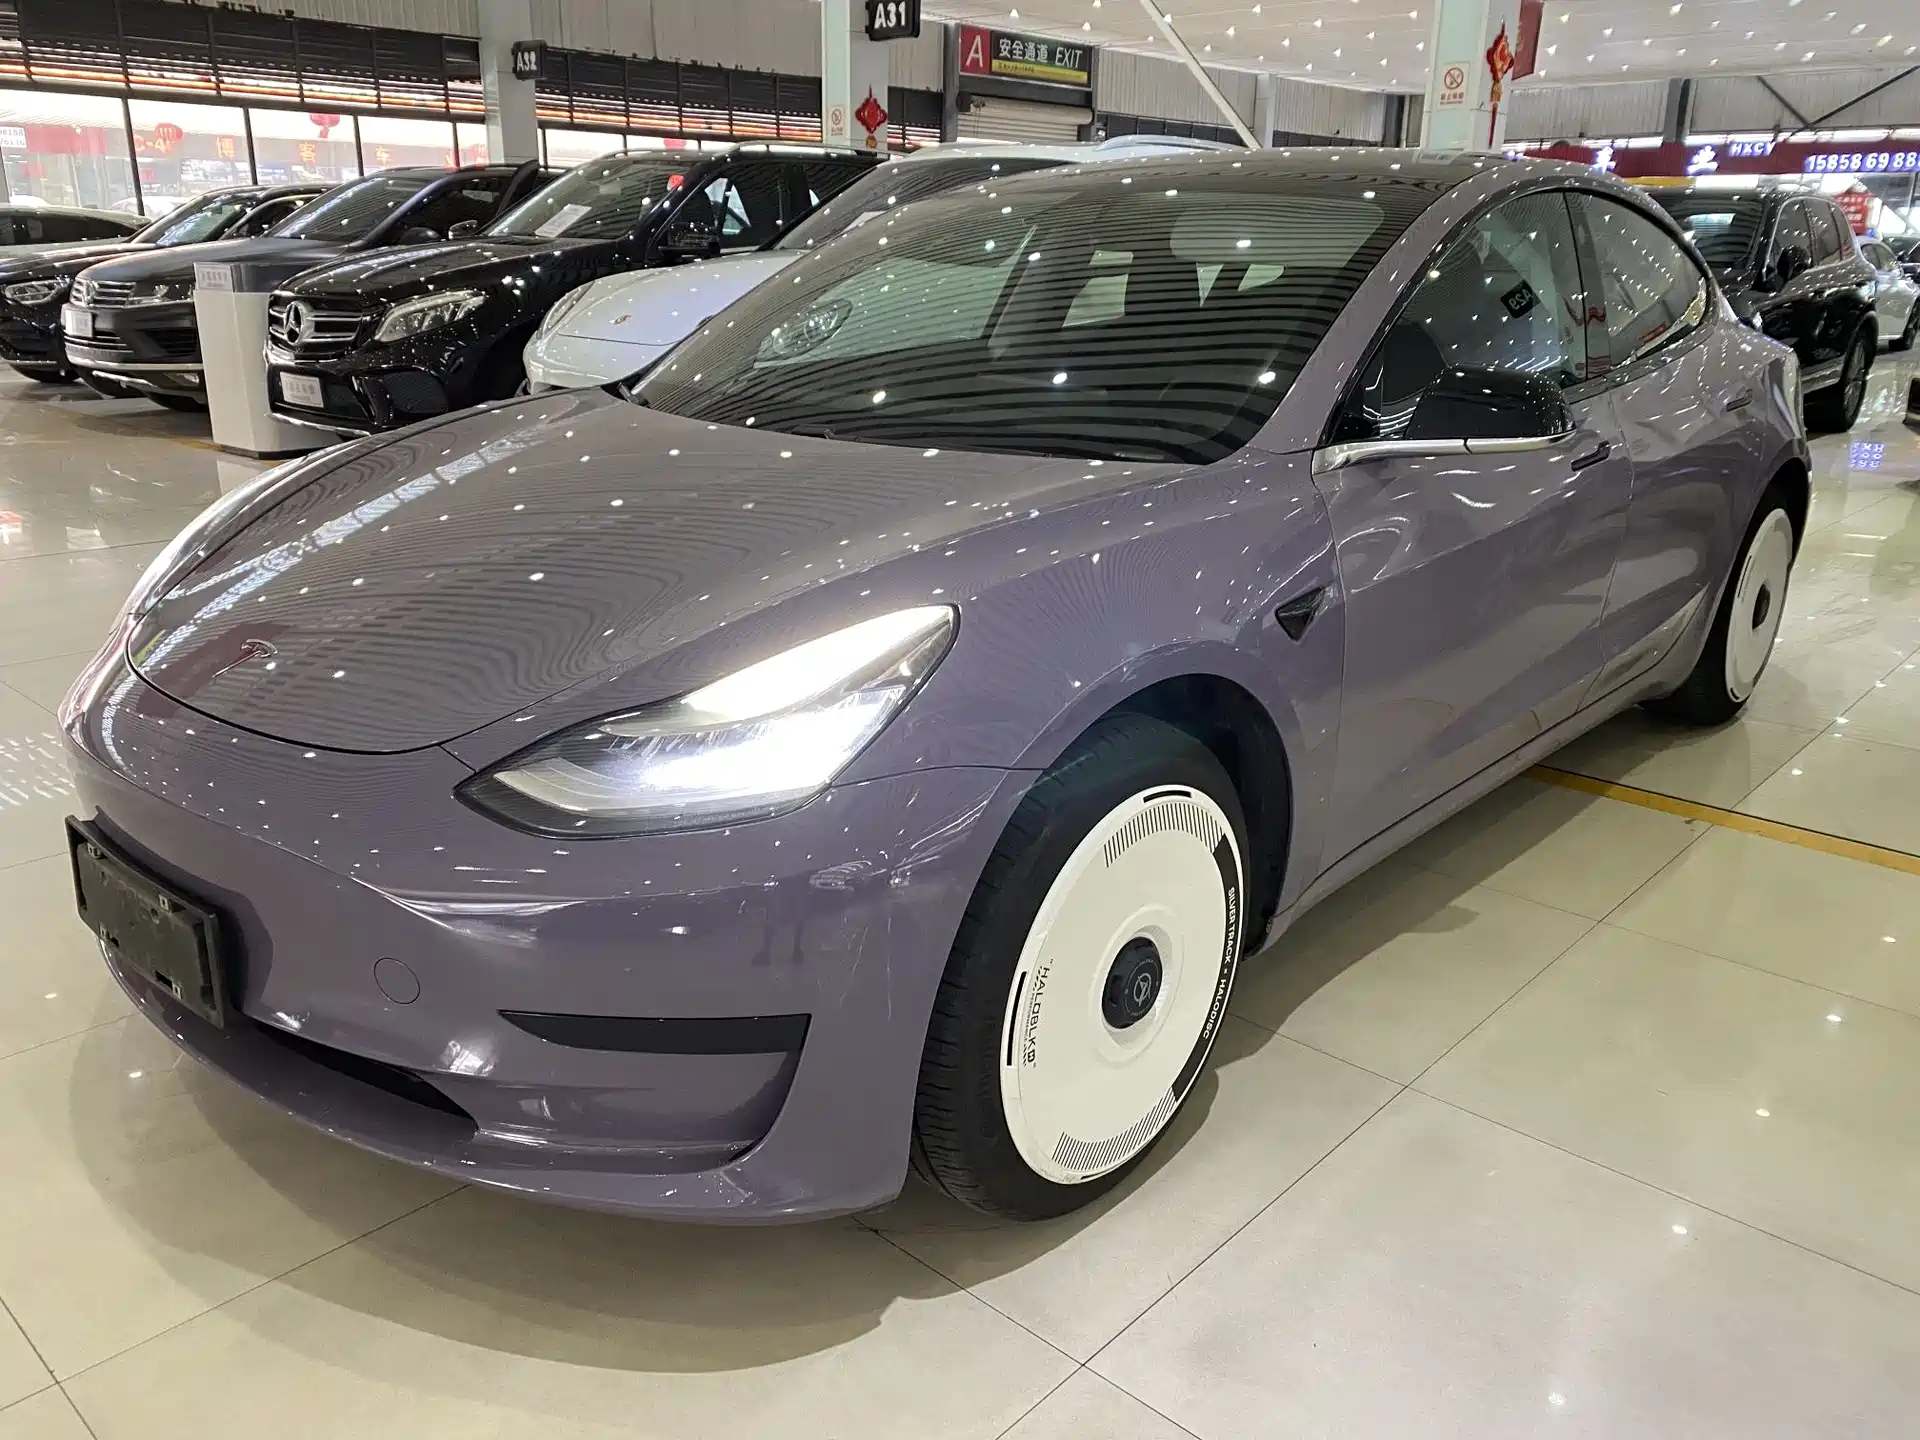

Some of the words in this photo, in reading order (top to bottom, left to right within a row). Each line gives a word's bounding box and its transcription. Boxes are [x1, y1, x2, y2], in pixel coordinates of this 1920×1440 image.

[874, 1, 906, 29] A31
[965, 34, 985, 68] A
[999, 38, 1049, 64] 安全通道
[1055, 46, 1083, 69] EXIT
[1807, 153, 1863, 170] 15858
[1865, 152, 1890, 169] 69
[1892, 151, 1920, 168] 88
[1203, 979, 1226, 1040] HALODISC
